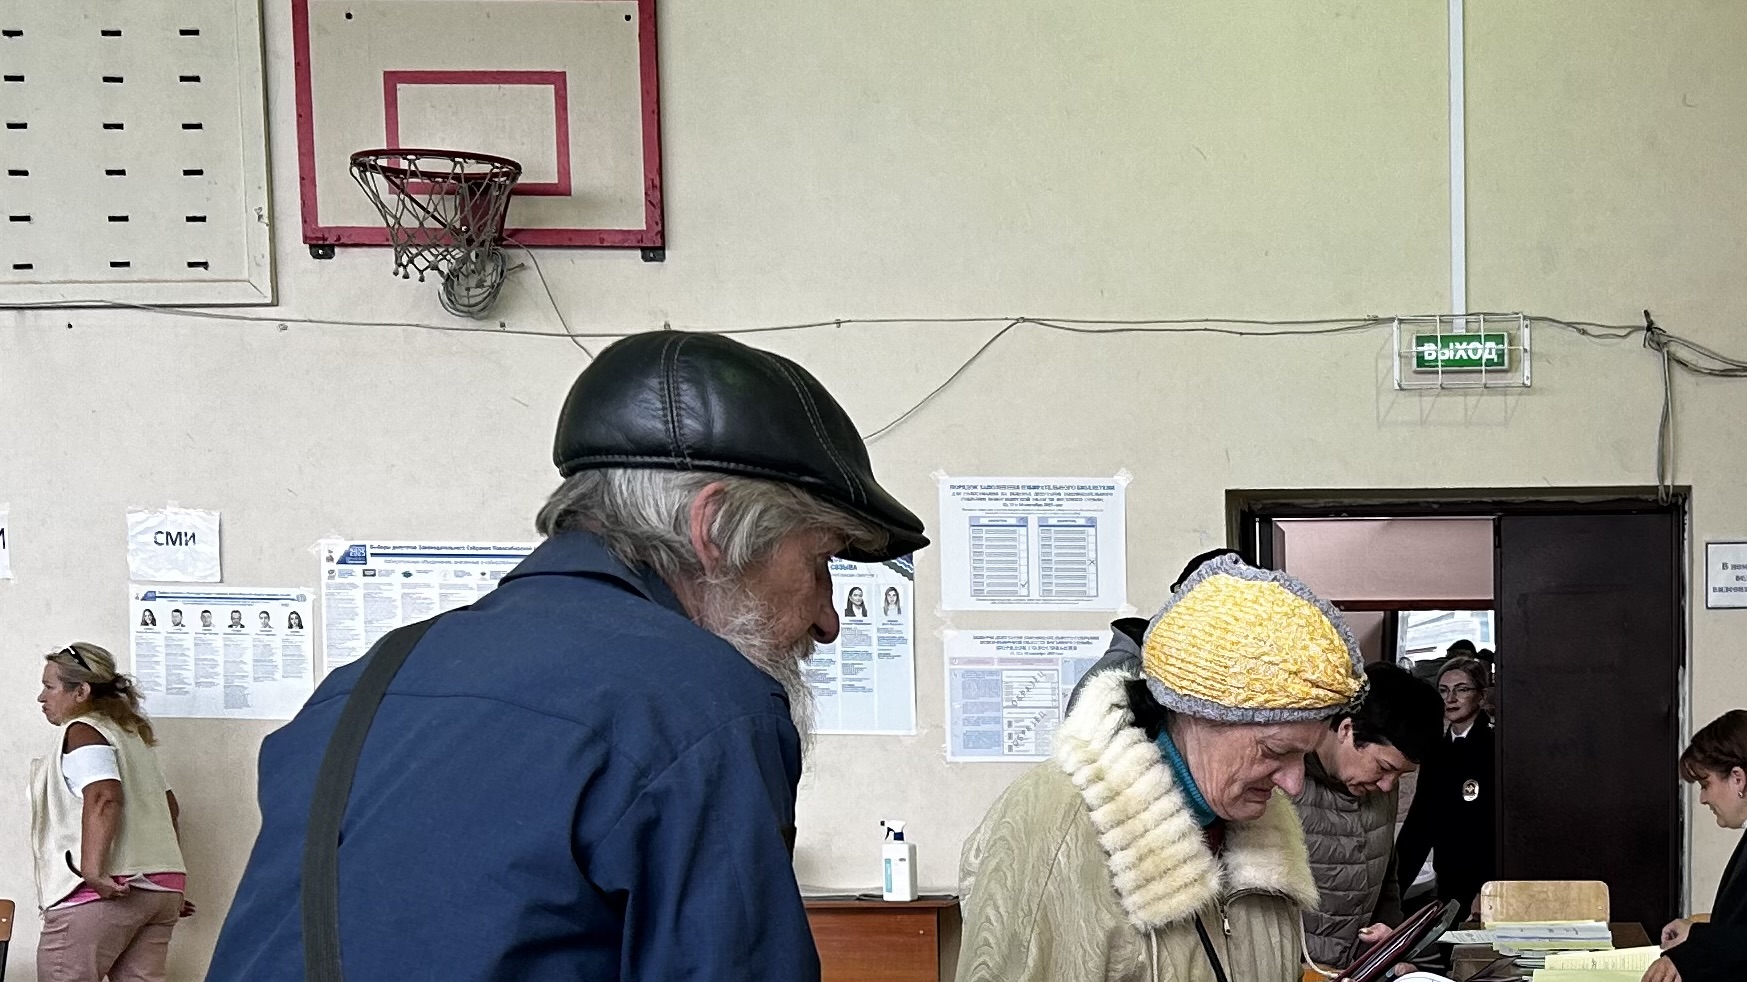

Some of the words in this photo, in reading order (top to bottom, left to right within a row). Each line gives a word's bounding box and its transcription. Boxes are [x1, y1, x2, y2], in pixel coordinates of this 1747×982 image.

[1424, 341, 1498, 362] ВЫХОД
[153, 530, 196, 547] СМИ
[1721, 562, 1729, 570] В
